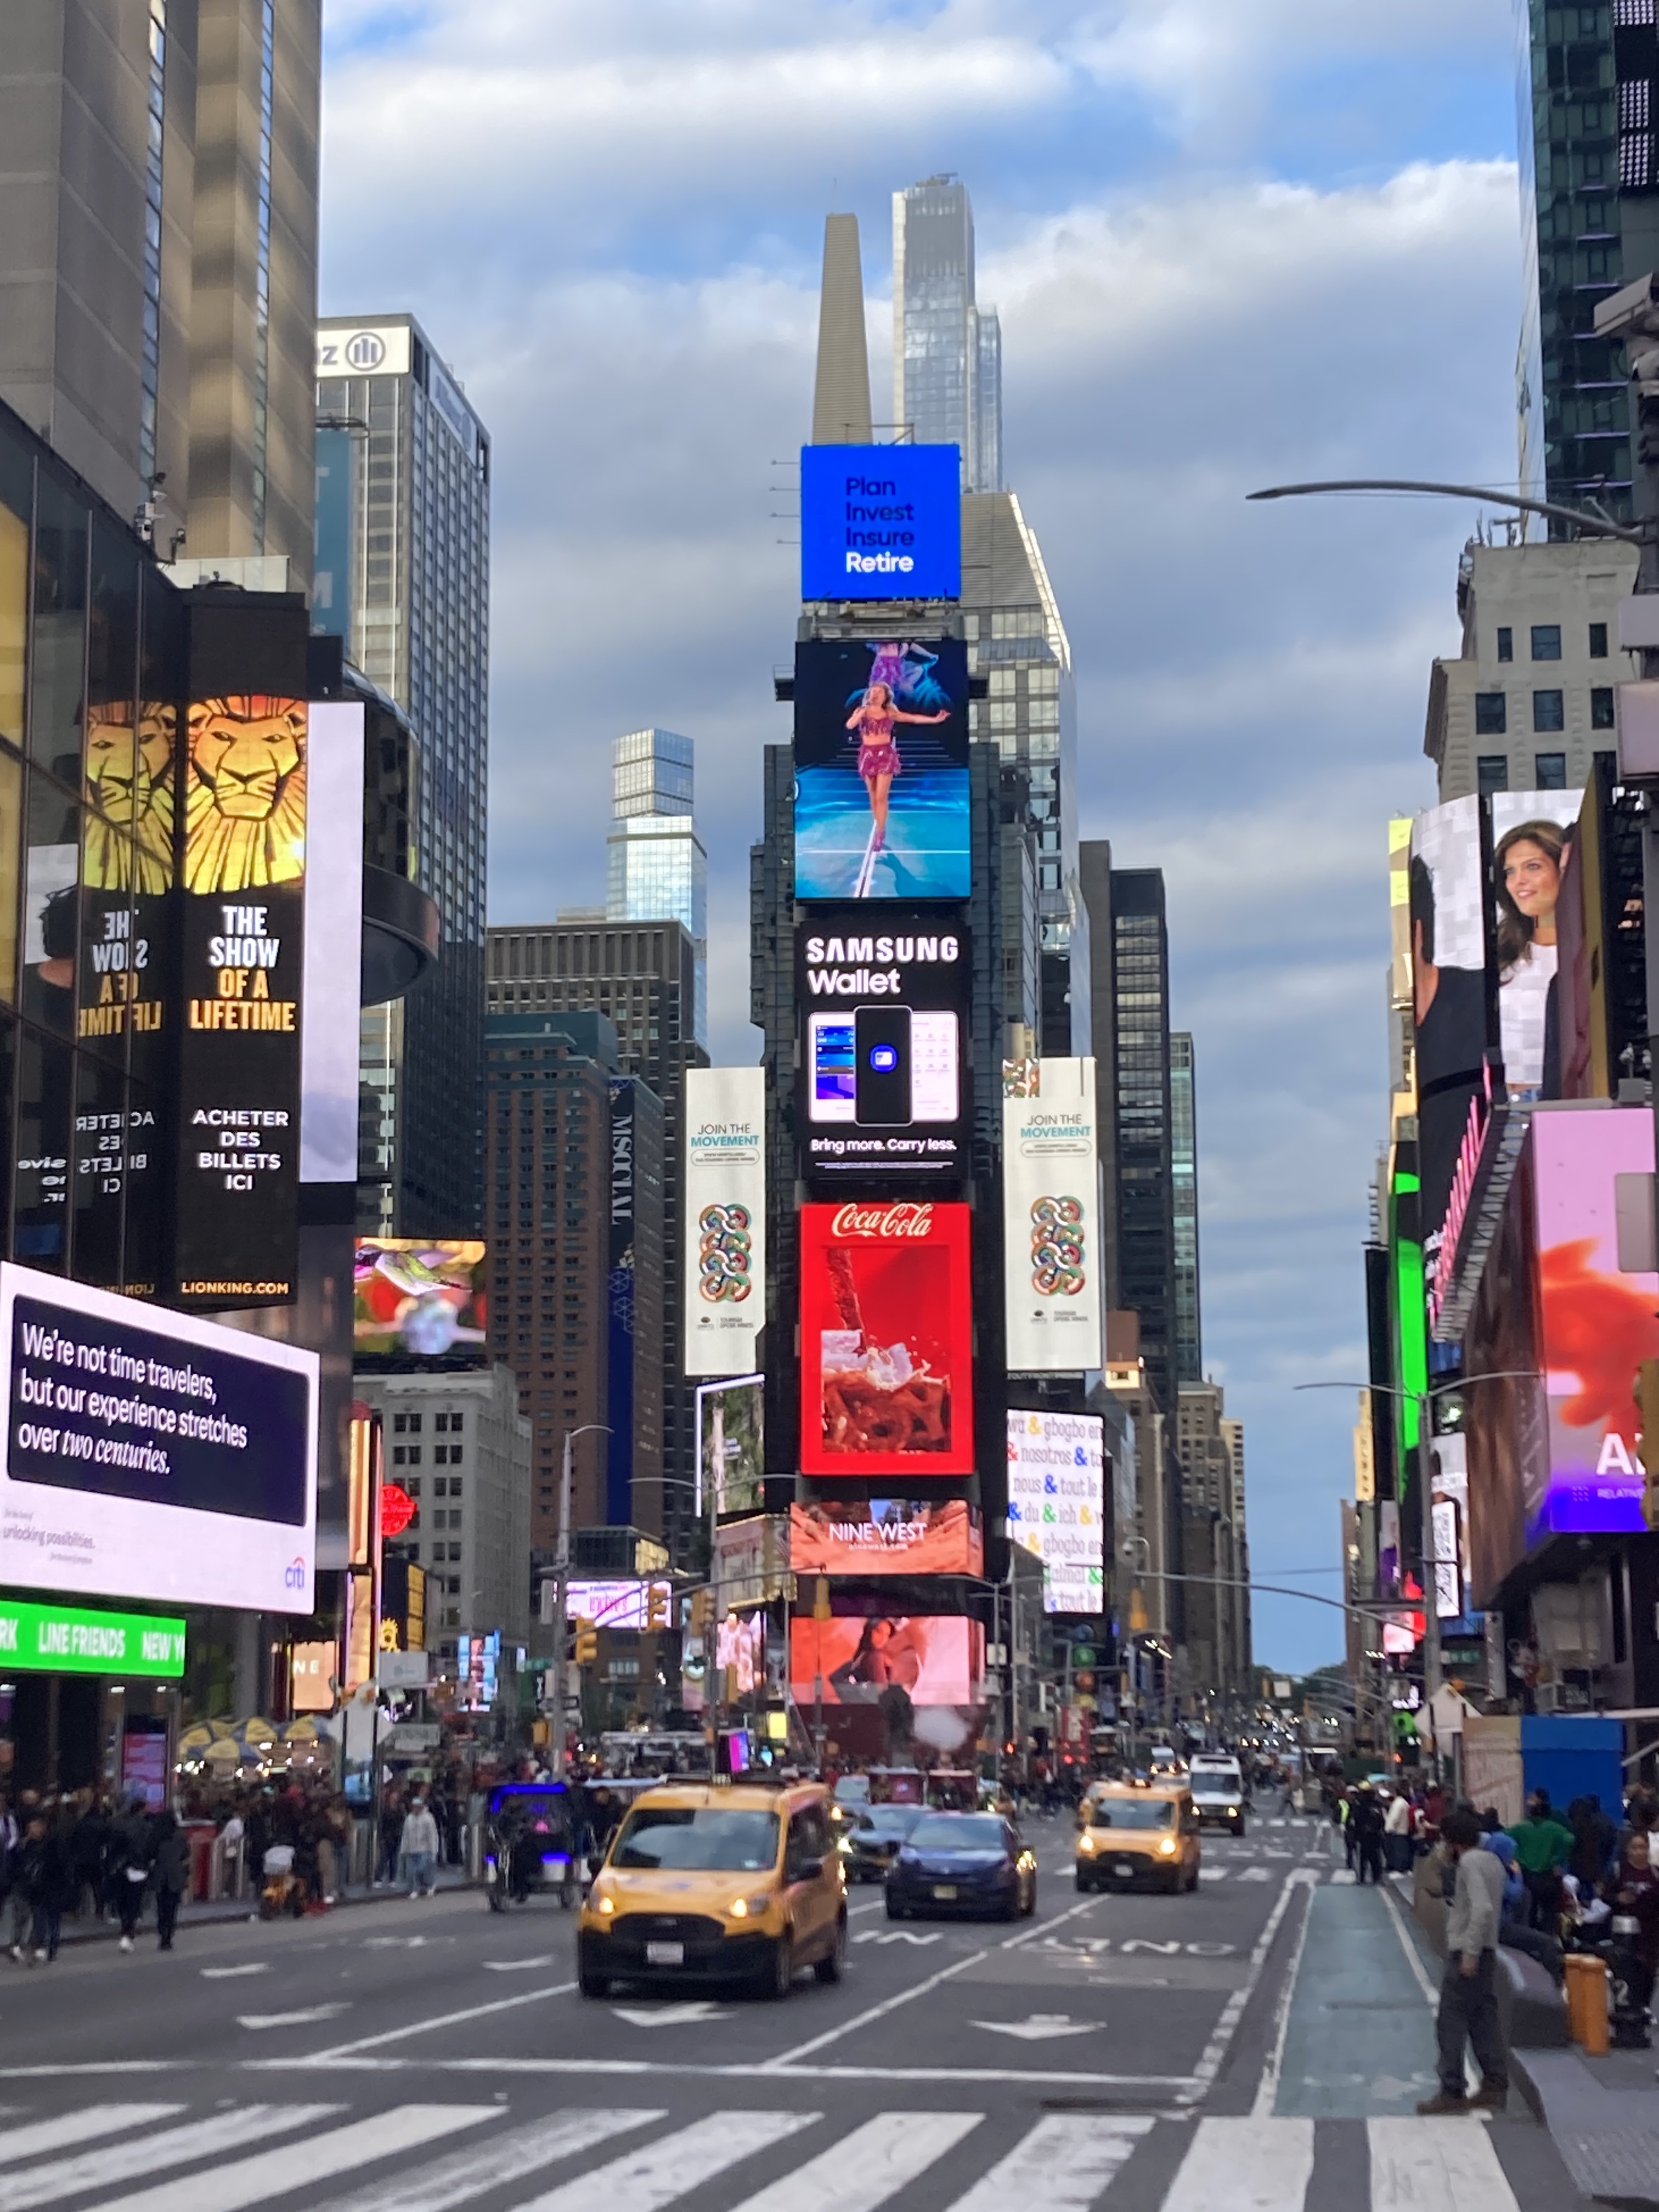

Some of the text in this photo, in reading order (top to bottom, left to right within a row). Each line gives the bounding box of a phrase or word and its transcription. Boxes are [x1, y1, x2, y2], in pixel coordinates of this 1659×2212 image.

[845, 476, 896, 496] Plan
[845, 501, 915, 522] Invest
[845, 526, 915, 547] Insure
[845, 551, 915, 573] Retire
[223, 905, 268, 935] THE
[209, 938, 280, 968] SHOW
[806, 935, 959, 964] SAMSUNG
[219, 969, 269, 999] OF A
[806, 968, 901, 995] Wallet
[190, 999, 297, 1031] LIFETIME
[193, 1109, 289, 1127] ACHETER
[1026, 1114, 1082, 1126] JOIN THE
[221, 1131, 261, 1148] DES
[697, 1123, 751, 1135] JOIN THE
[1020, 1126, 1091, 1138] MOVEMENT
[690, 1135, 760, 1147] MOVEMENT
[810, 1138, 957, 1155] Bring more. Carry less.
[199, 1153, 281, 1170] BILLETS
[225, 1175, 253, 1190] ICI
[832, 1203, 934, 1237] Coca-Cola
[181, 1281, 289, 1295] LIONKING.COM
[22, 1322, 217, 1406] We're not time travelers,
[20, 1367, 247, 1449] but our experience stretches
[19, 1423, 171, 1475] over two centuries.
[1021, 1446, 1072, 1465] nosotros
[1013, 1477, 1042, 1494] nous
[1060, 1476, 1086, 1497] tout
[1087, 1475, 1098, 1498] le
[1024, 1500, 1040, 1522] du
[1058, 1503, 1077, 1525] ich
[829, 1522, 928, 1542] NINE WEST
[38, 1621, 70, 1656] LINE
[71, 1624, 127, 1660] FRIENDS
[141, 1630, 172, 1662] NEW
